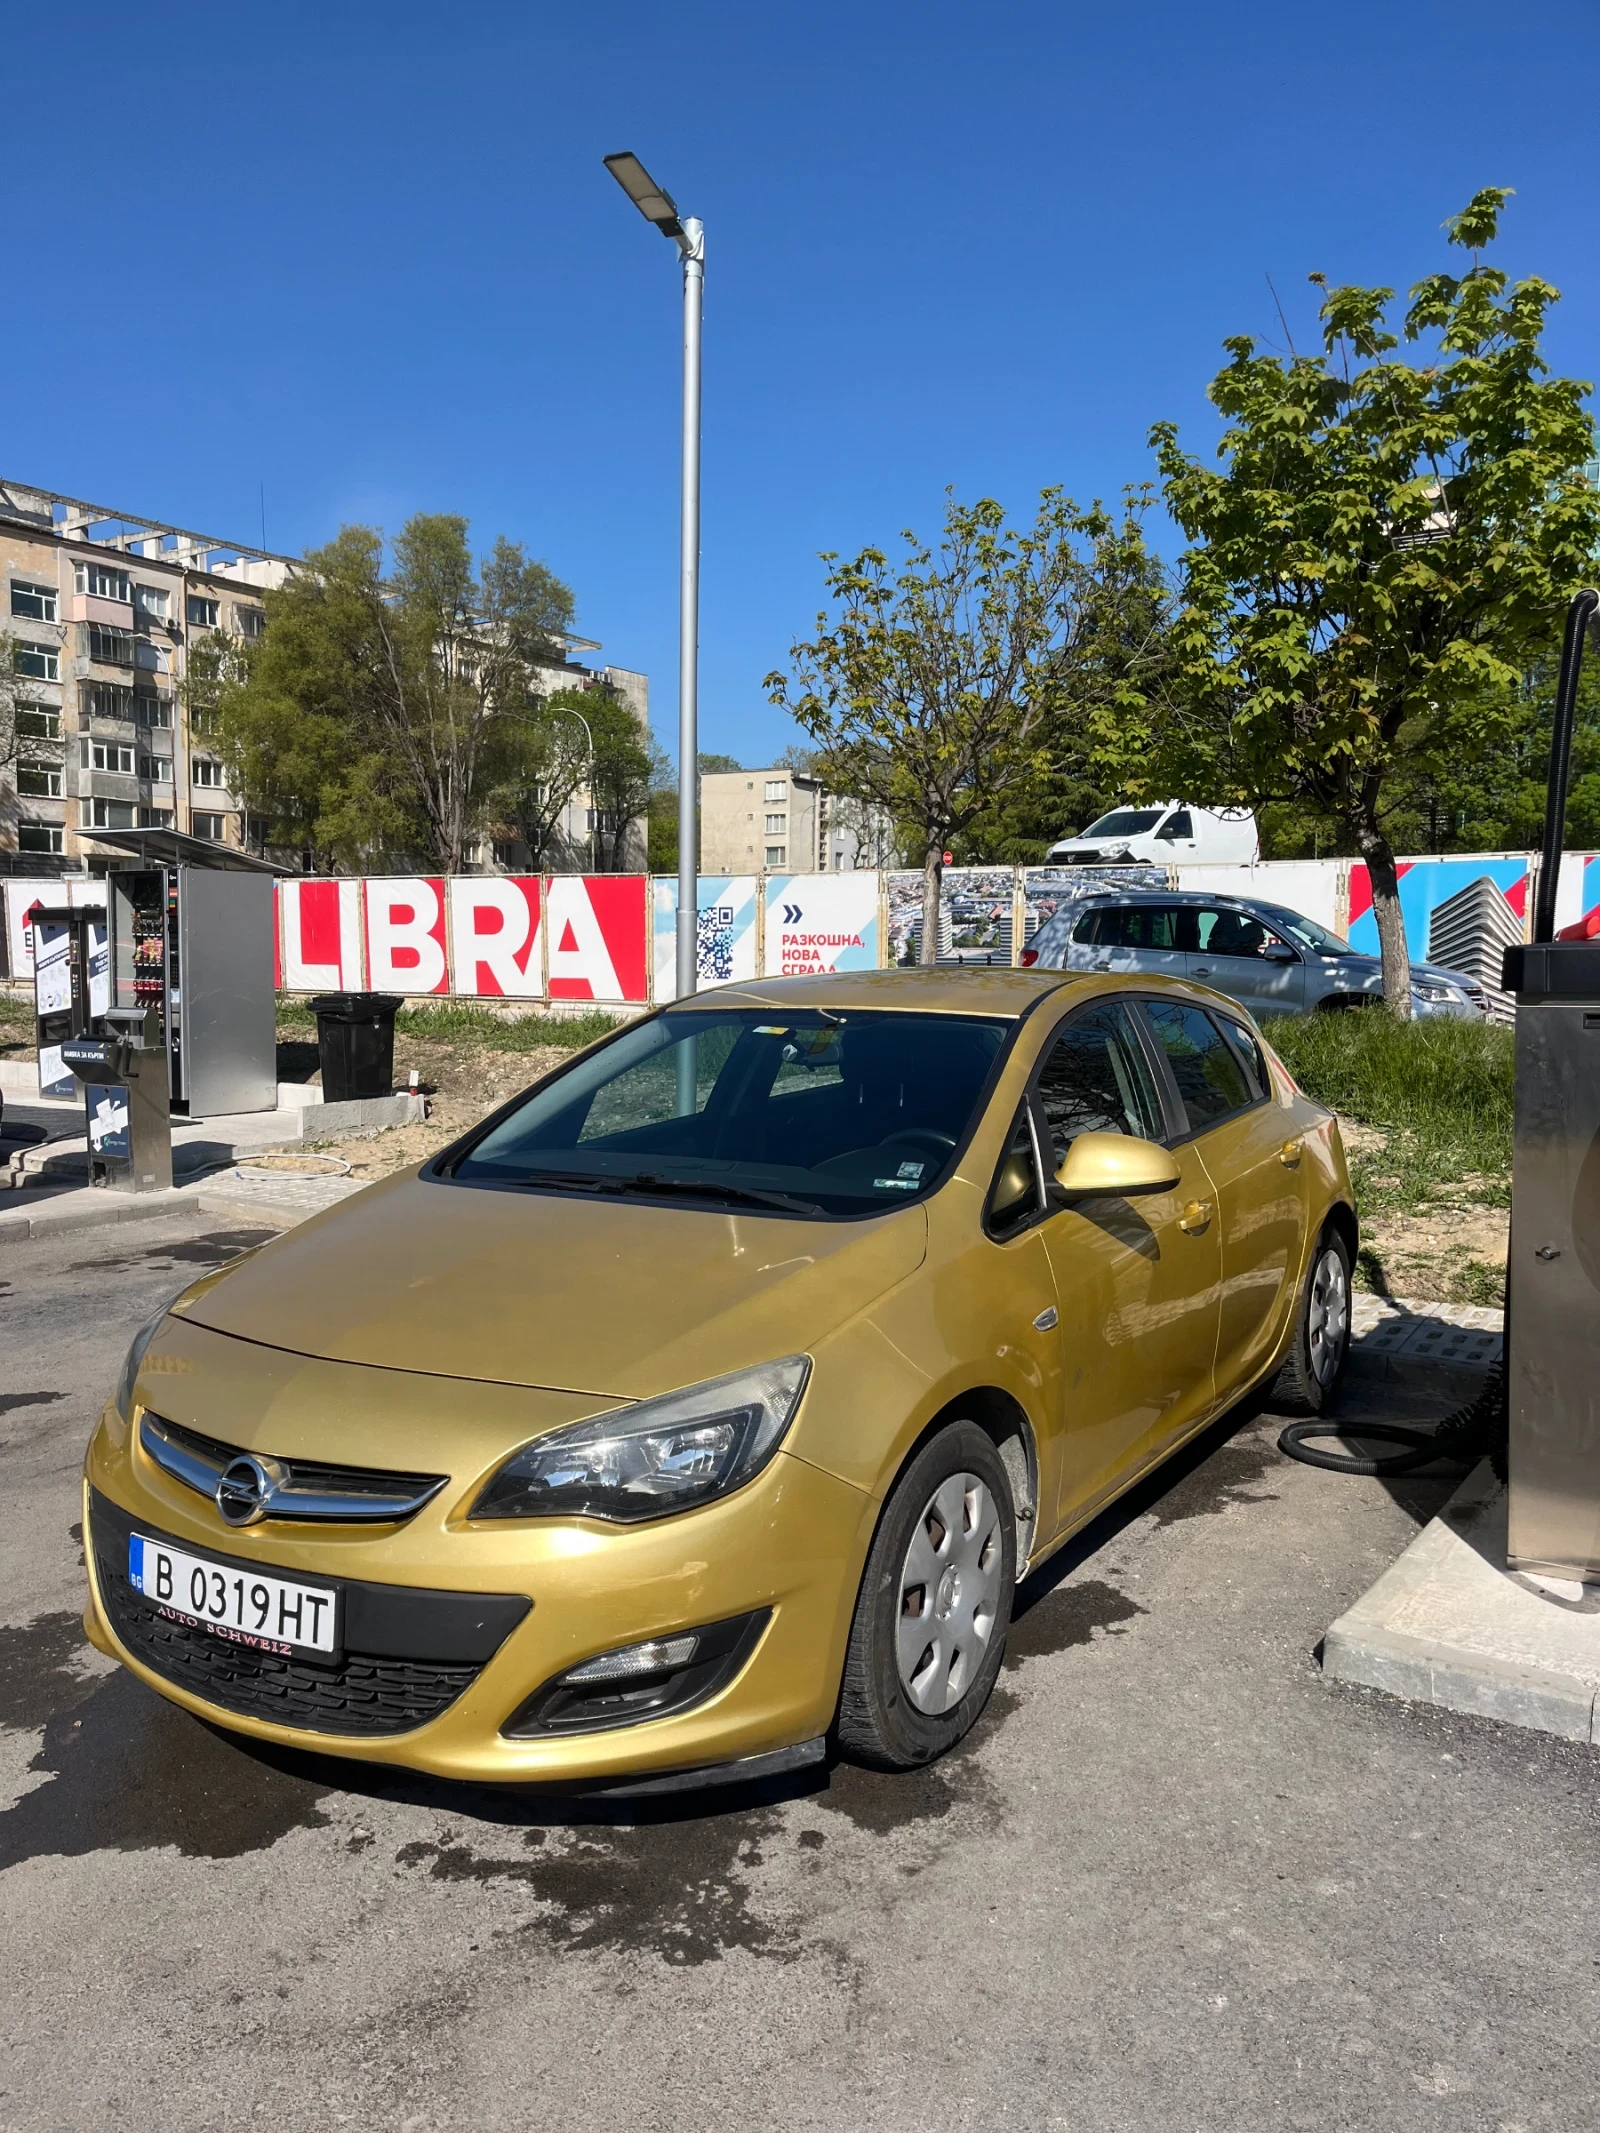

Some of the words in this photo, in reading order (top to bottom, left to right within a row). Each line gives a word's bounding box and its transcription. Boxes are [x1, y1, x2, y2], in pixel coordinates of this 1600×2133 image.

[283, 877, 625, 1001] LIBRA
[782, 934, 865, 948] РАЗКОШНА,
[782, 949, 821, 961] НОВА
[131, 1573, 143, 1589] BG
[156, 1554, 174, 1601] B
[157, 1604, 199, 1628] AUTO
[206, 1622, 293, 1656] SCHWEIZ
